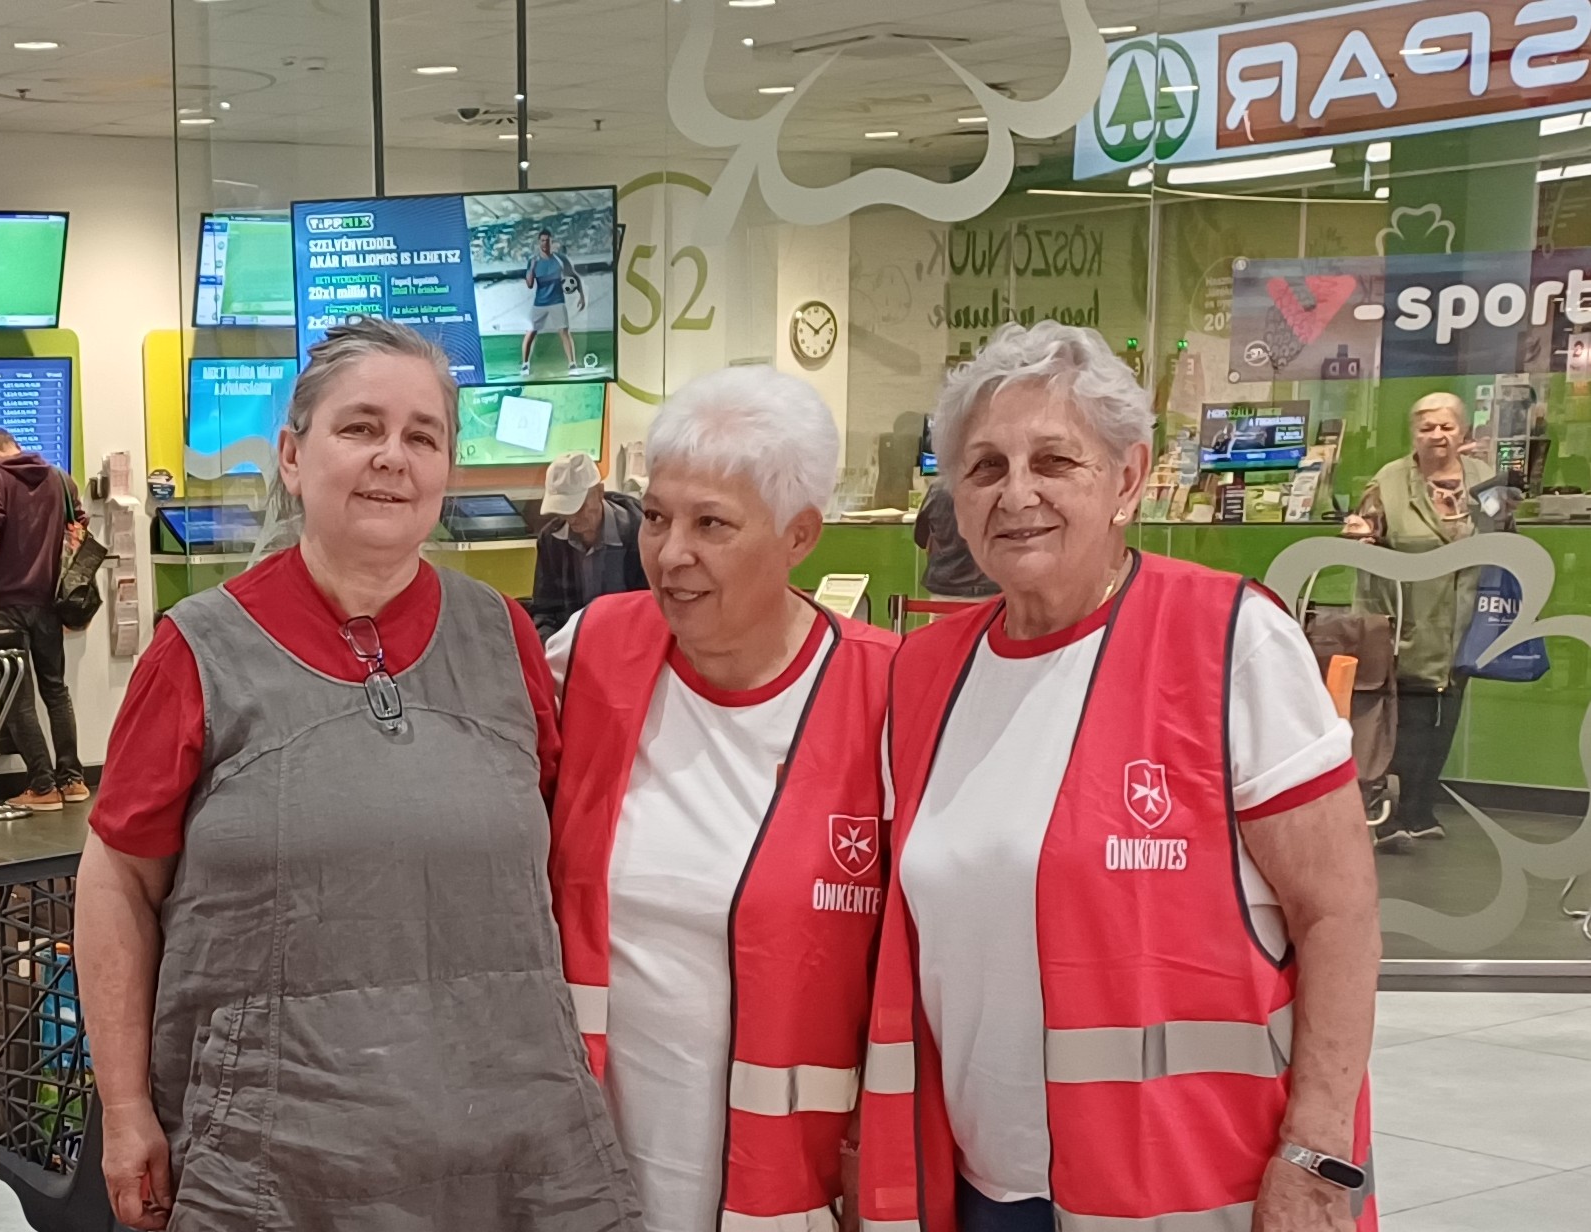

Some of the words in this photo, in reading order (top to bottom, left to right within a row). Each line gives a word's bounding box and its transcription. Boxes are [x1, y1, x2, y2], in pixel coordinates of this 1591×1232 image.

[310, 252, 340, 269] AKÁR
[401, 251, 411, 265] IS
[621, 244, 715, 335] 52
[812, 878, 882, 915] ÖNKÉNTE
